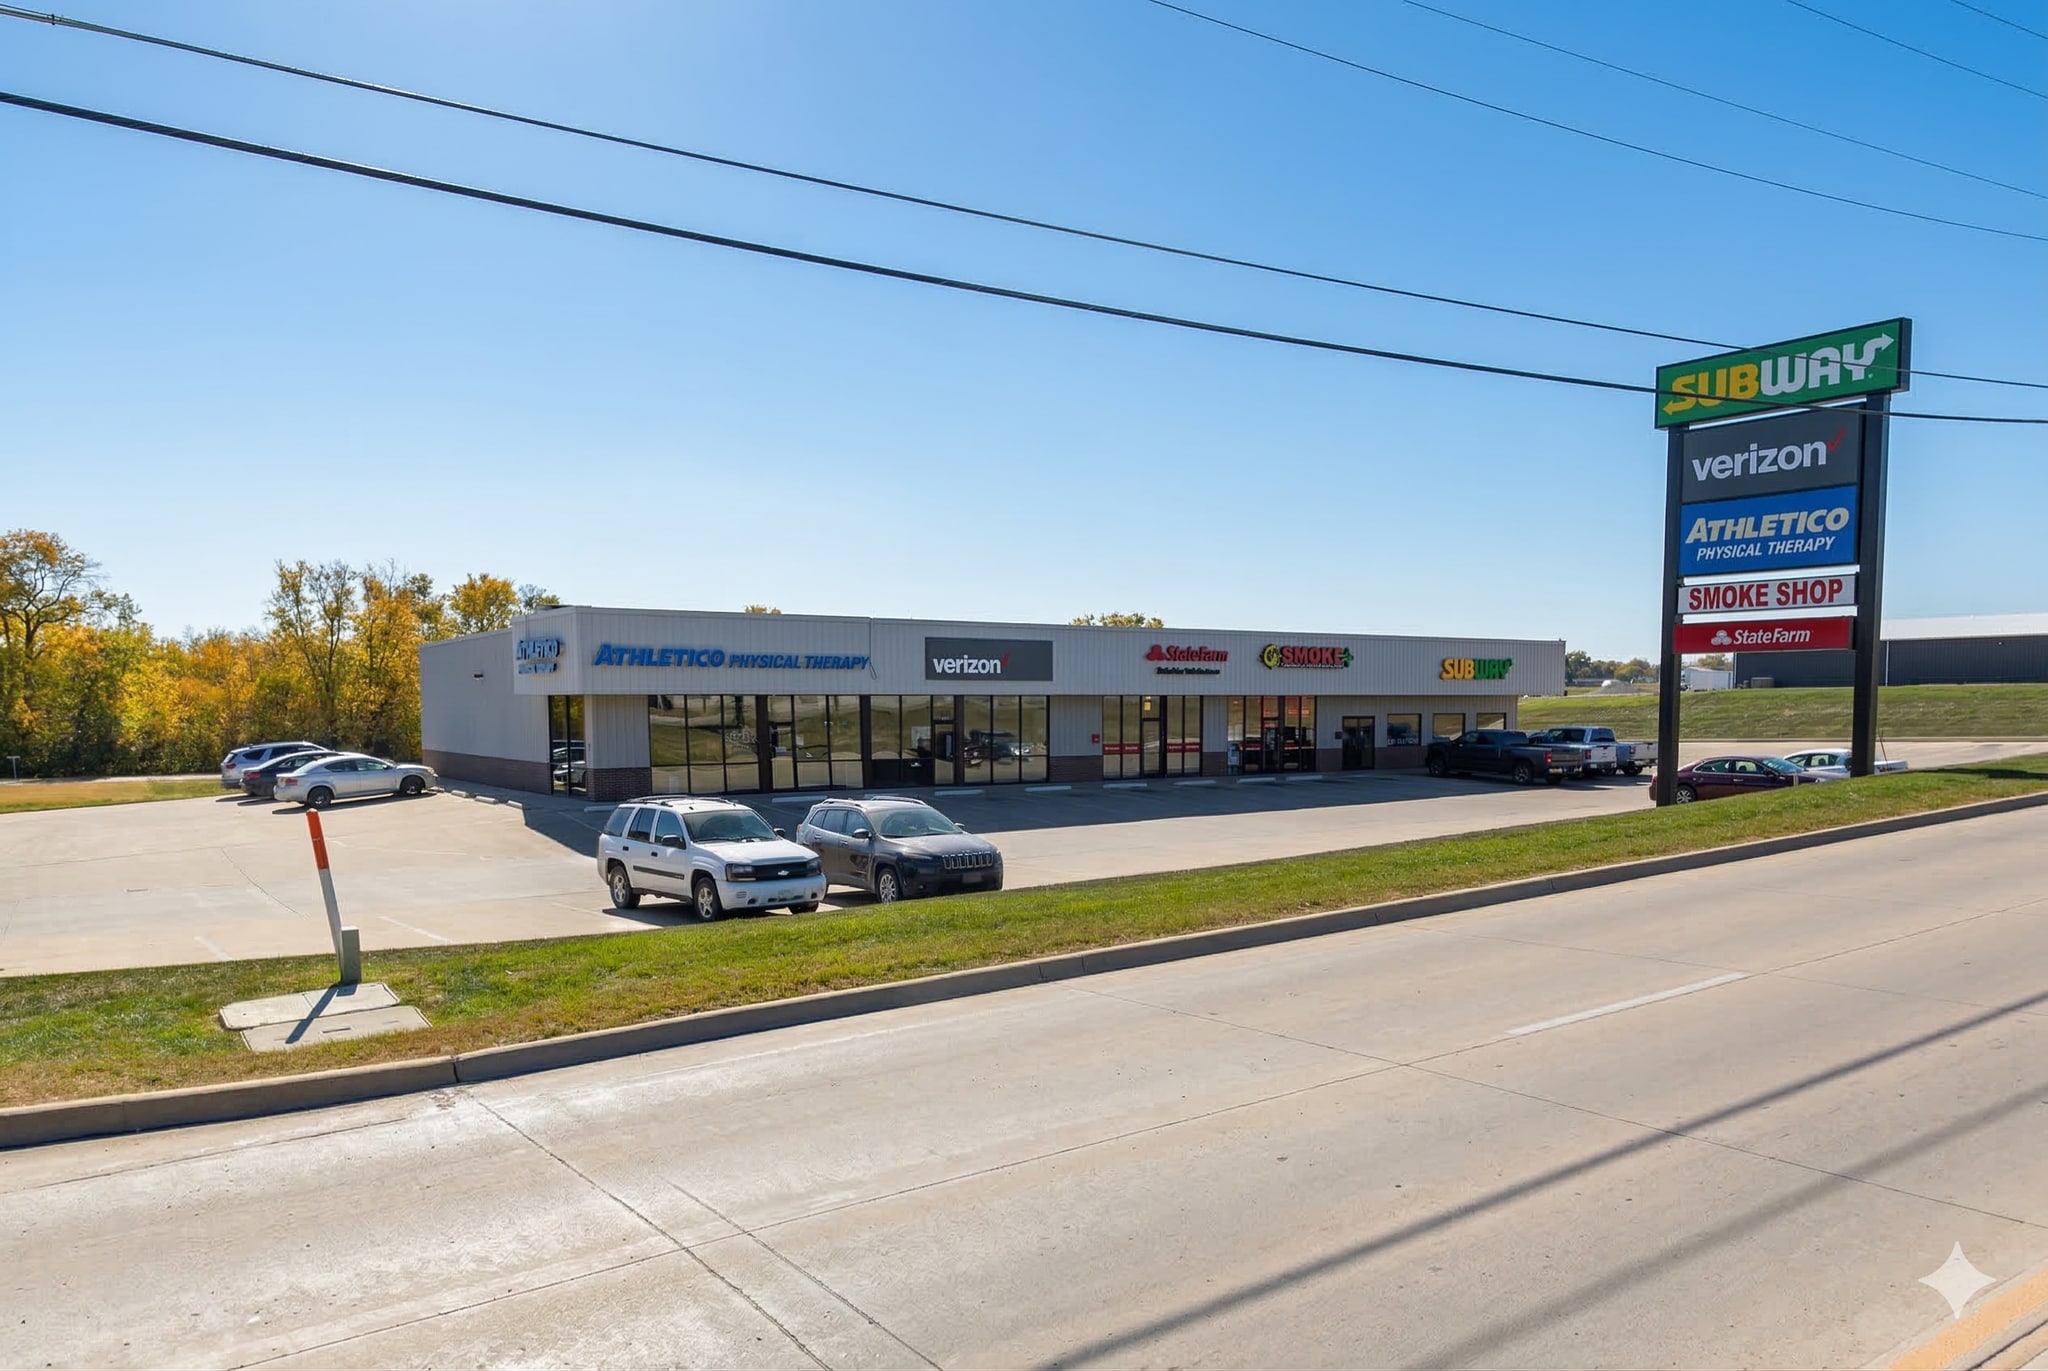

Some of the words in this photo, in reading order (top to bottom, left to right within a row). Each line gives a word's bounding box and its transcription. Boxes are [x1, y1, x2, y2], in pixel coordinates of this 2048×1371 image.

[1662, 332, 1895, 416] SUBWAY
[1691, 440, 1828, 482] verizon
[1685, 507, 1850, 544] ATHLETICO
[1696, 542, 1763, 562] PHYSICAL
[1767, 536, 1837, 556] THERAPY
[1688, 583, 1769, 611] SMOKE
[1776, 578, 1843, 606] SHOP
[594, 643, 725, 668] ATHLETICO
[729, 653, 800, 669] PHYSICAL
[804, 655, 870, 670] THERAPY
[933, 655, 1001, 674] verizon
[1281, 645, 1344, 664] SMOKE
[1440, 657, 1512, 680] SUBWAY
